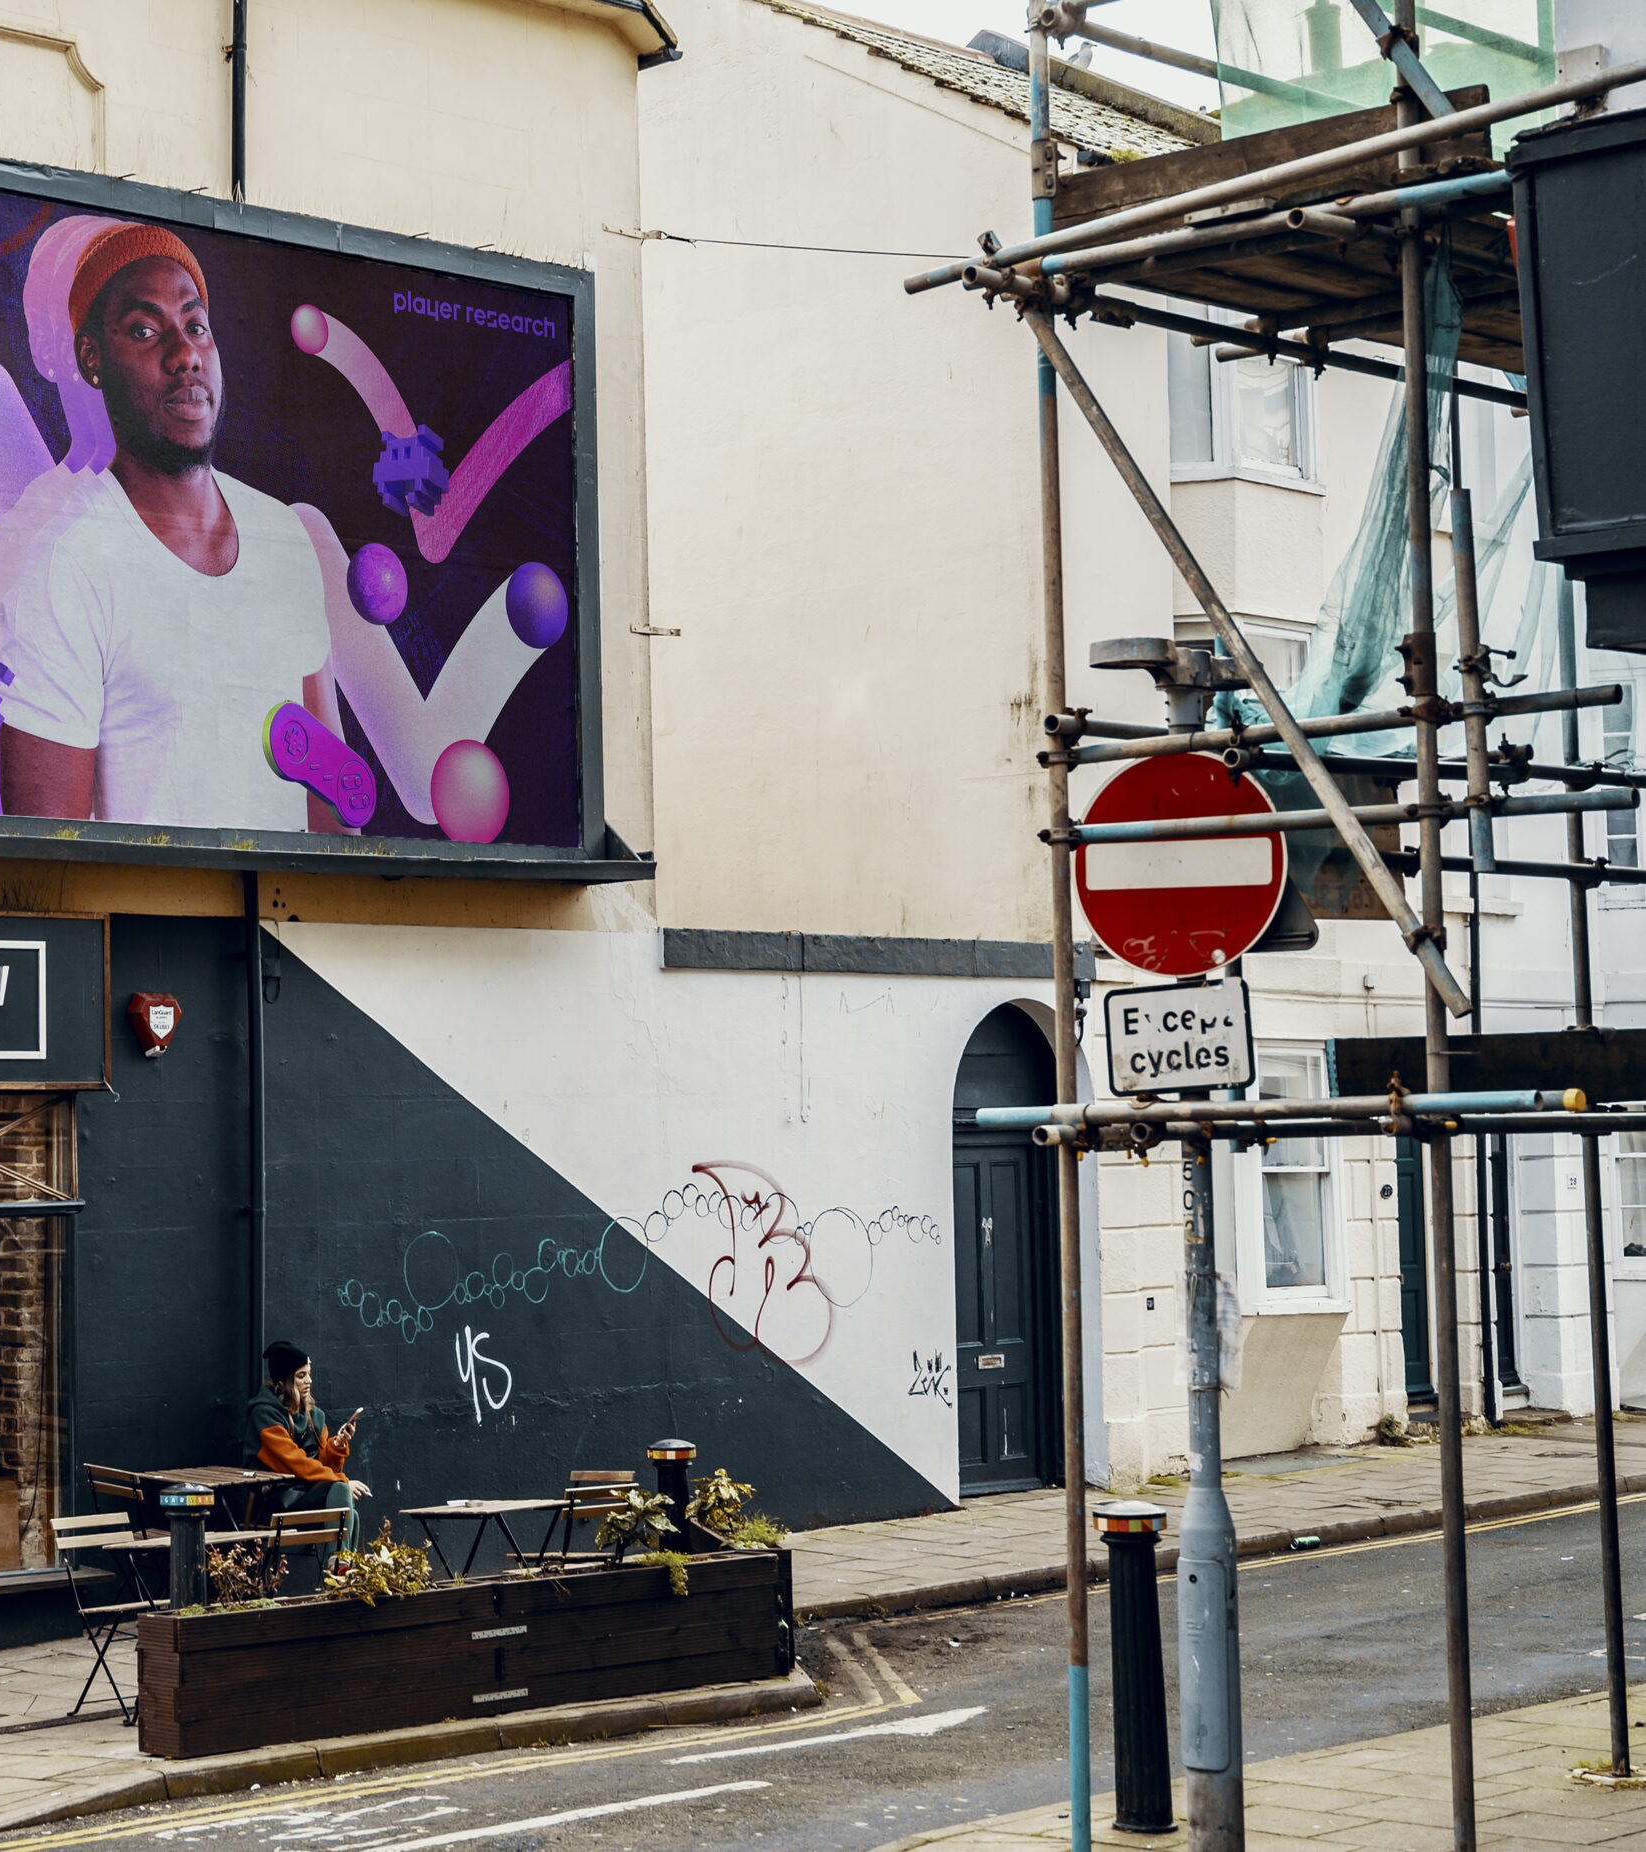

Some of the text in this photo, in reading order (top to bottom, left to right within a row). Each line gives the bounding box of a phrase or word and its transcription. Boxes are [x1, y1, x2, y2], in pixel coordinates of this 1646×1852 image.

[394, 291, 555, 339] player research
[1130, 1041, 1230, 1077] cycles
